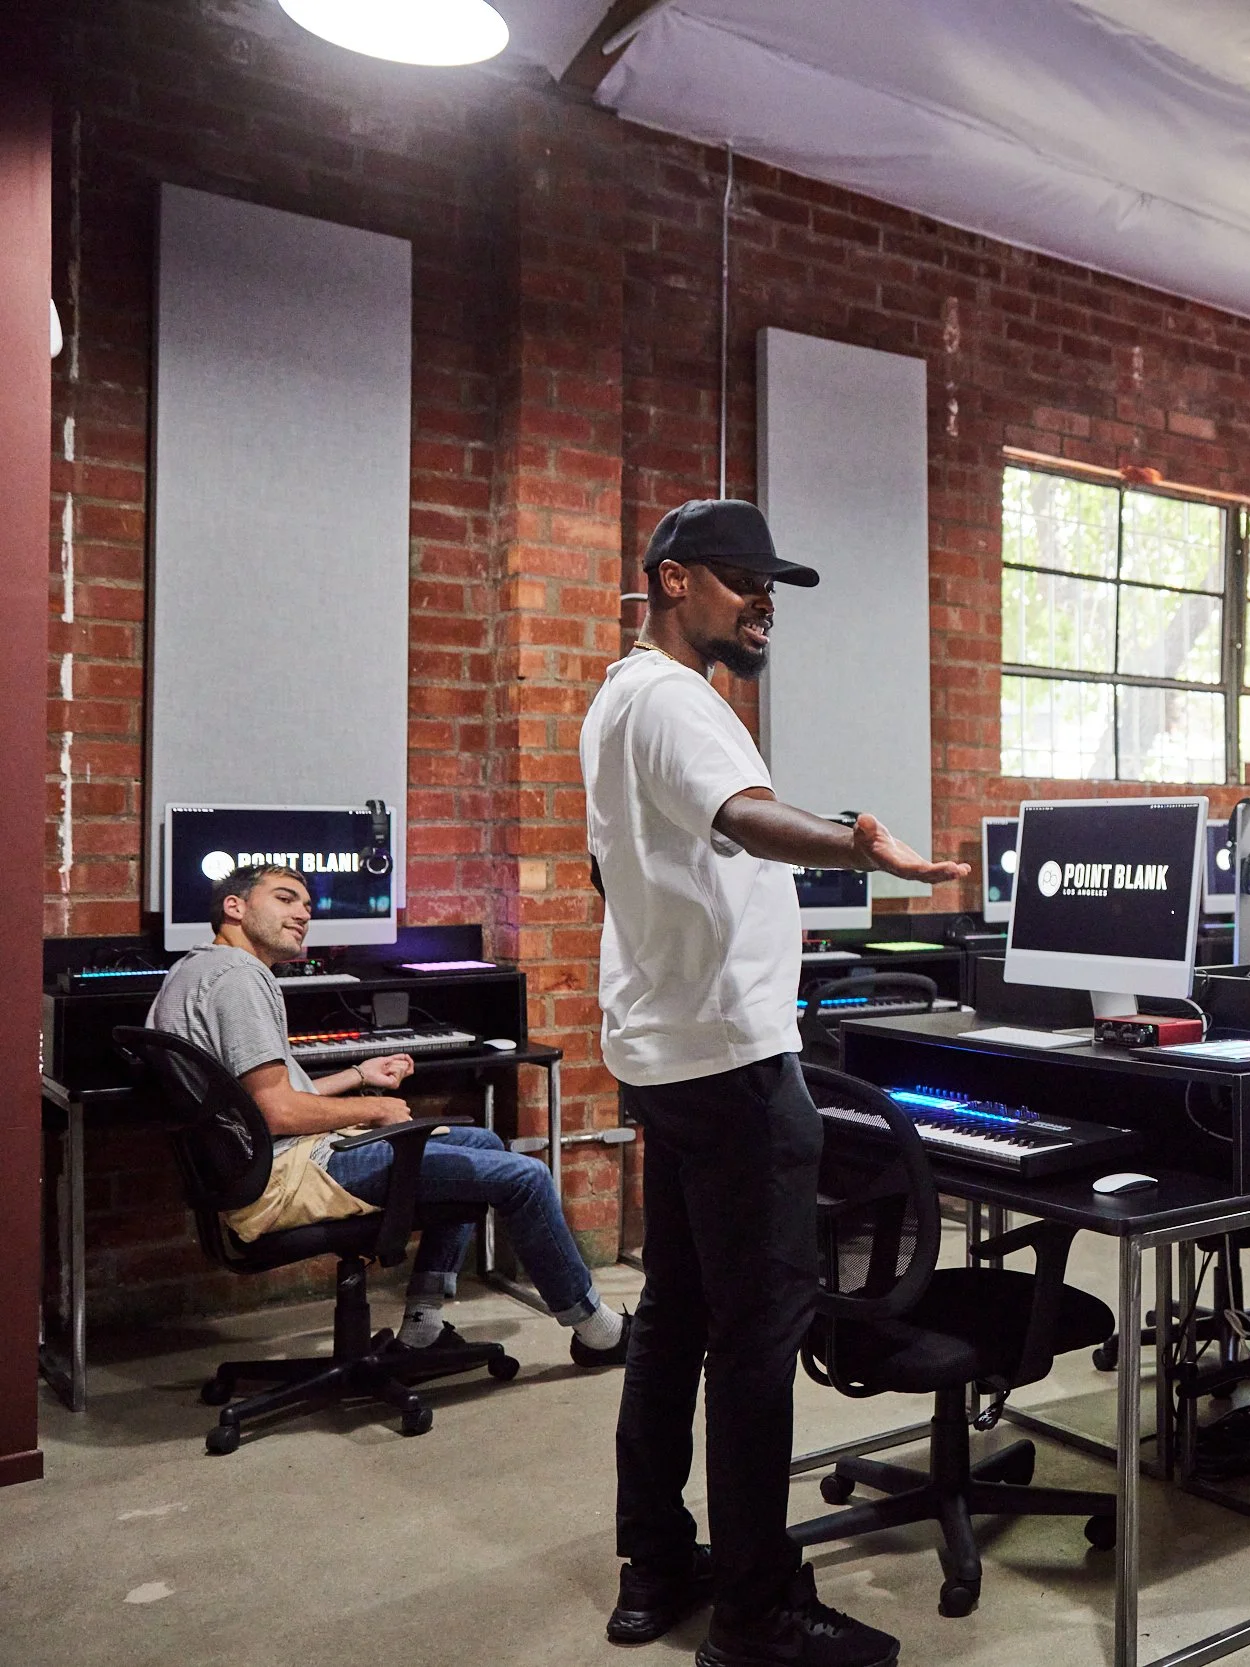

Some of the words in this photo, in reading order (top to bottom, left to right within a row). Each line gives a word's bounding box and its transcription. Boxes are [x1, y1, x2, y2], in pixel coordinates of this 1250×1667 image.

[1063, 863, 1113, 889] POINT
[1113, 863, 1170, 890] BLANK
[1062, 888, 1076, 896] LOS
[1077, 888, 1108, 897] ANGELES
